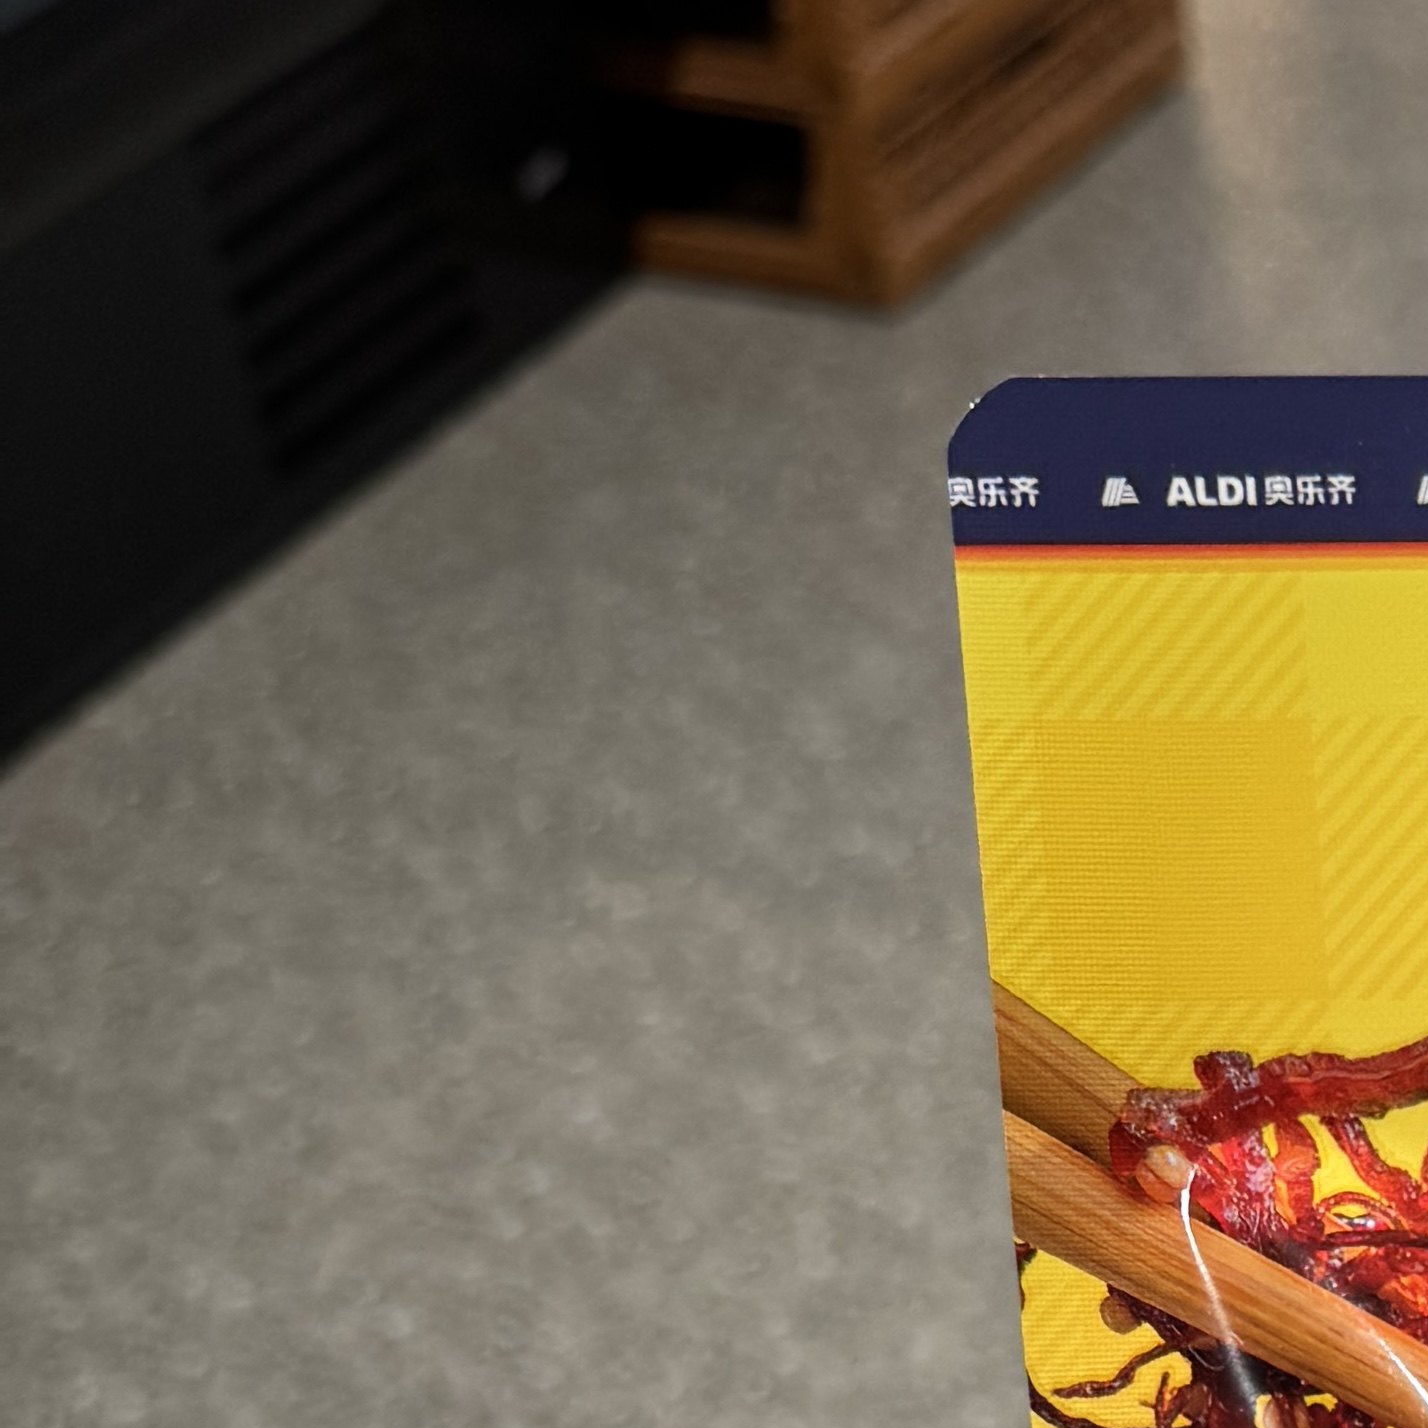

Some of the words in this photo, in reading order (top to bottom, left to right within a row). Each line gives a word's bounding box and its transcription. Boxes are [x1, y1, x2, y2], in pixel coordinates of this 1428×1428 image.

[947, 476, 1039, 507] 奥乐齐
[1166, 475, 1258, 507] ALDI
[1264, 474, 1356, 506] 奥乐齐
